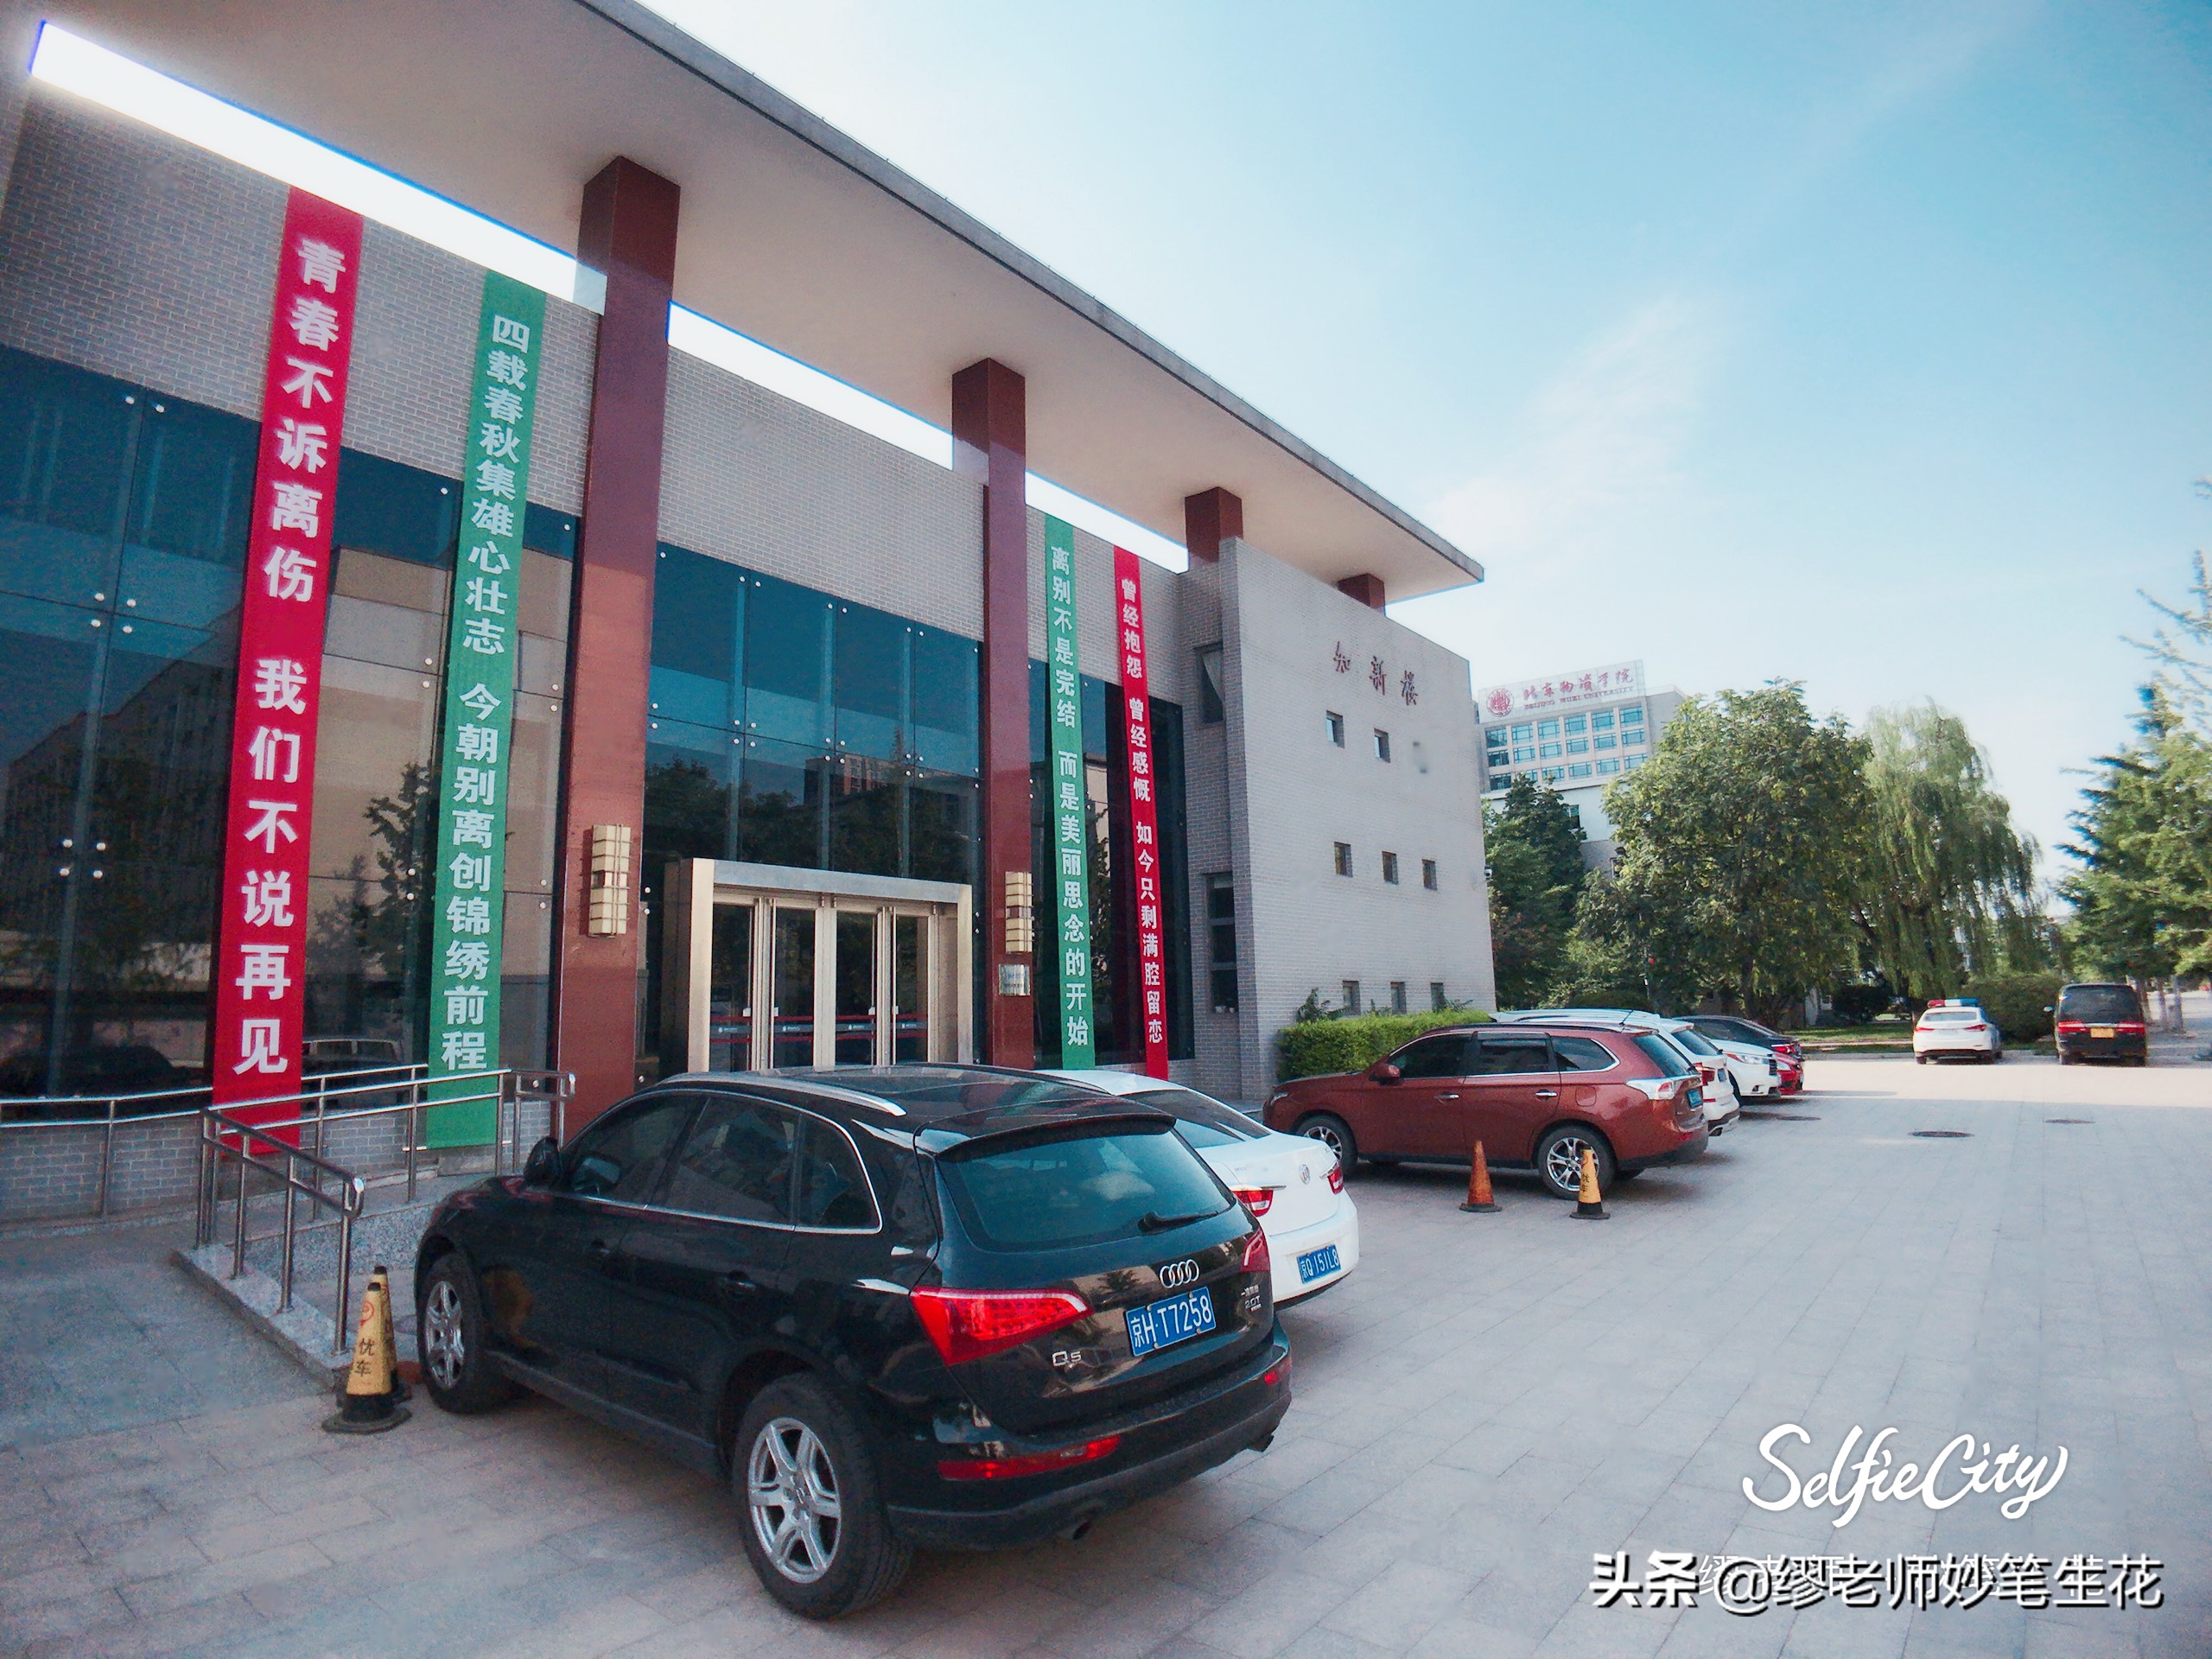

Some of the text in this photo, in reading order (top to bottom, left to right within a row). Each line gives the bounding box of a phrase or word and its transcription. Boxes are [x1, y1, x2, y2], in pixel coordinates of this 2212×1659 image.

[233, 237, 346, 1077] 青春不诉离伤 我们不说再见
[441, 314, 531, 1071] 四载春秋集雄心壮志 今朝别离创锦绣前程
[1050, 546, 1090, 1046] 离别不是完结 而是美丽思念的开始
[1121, 578, 1163, 1044] 曾经抱怨 曾经感慨 如今只剩满腔留恋
[1052, 1351, 1082, 1367] Q5
